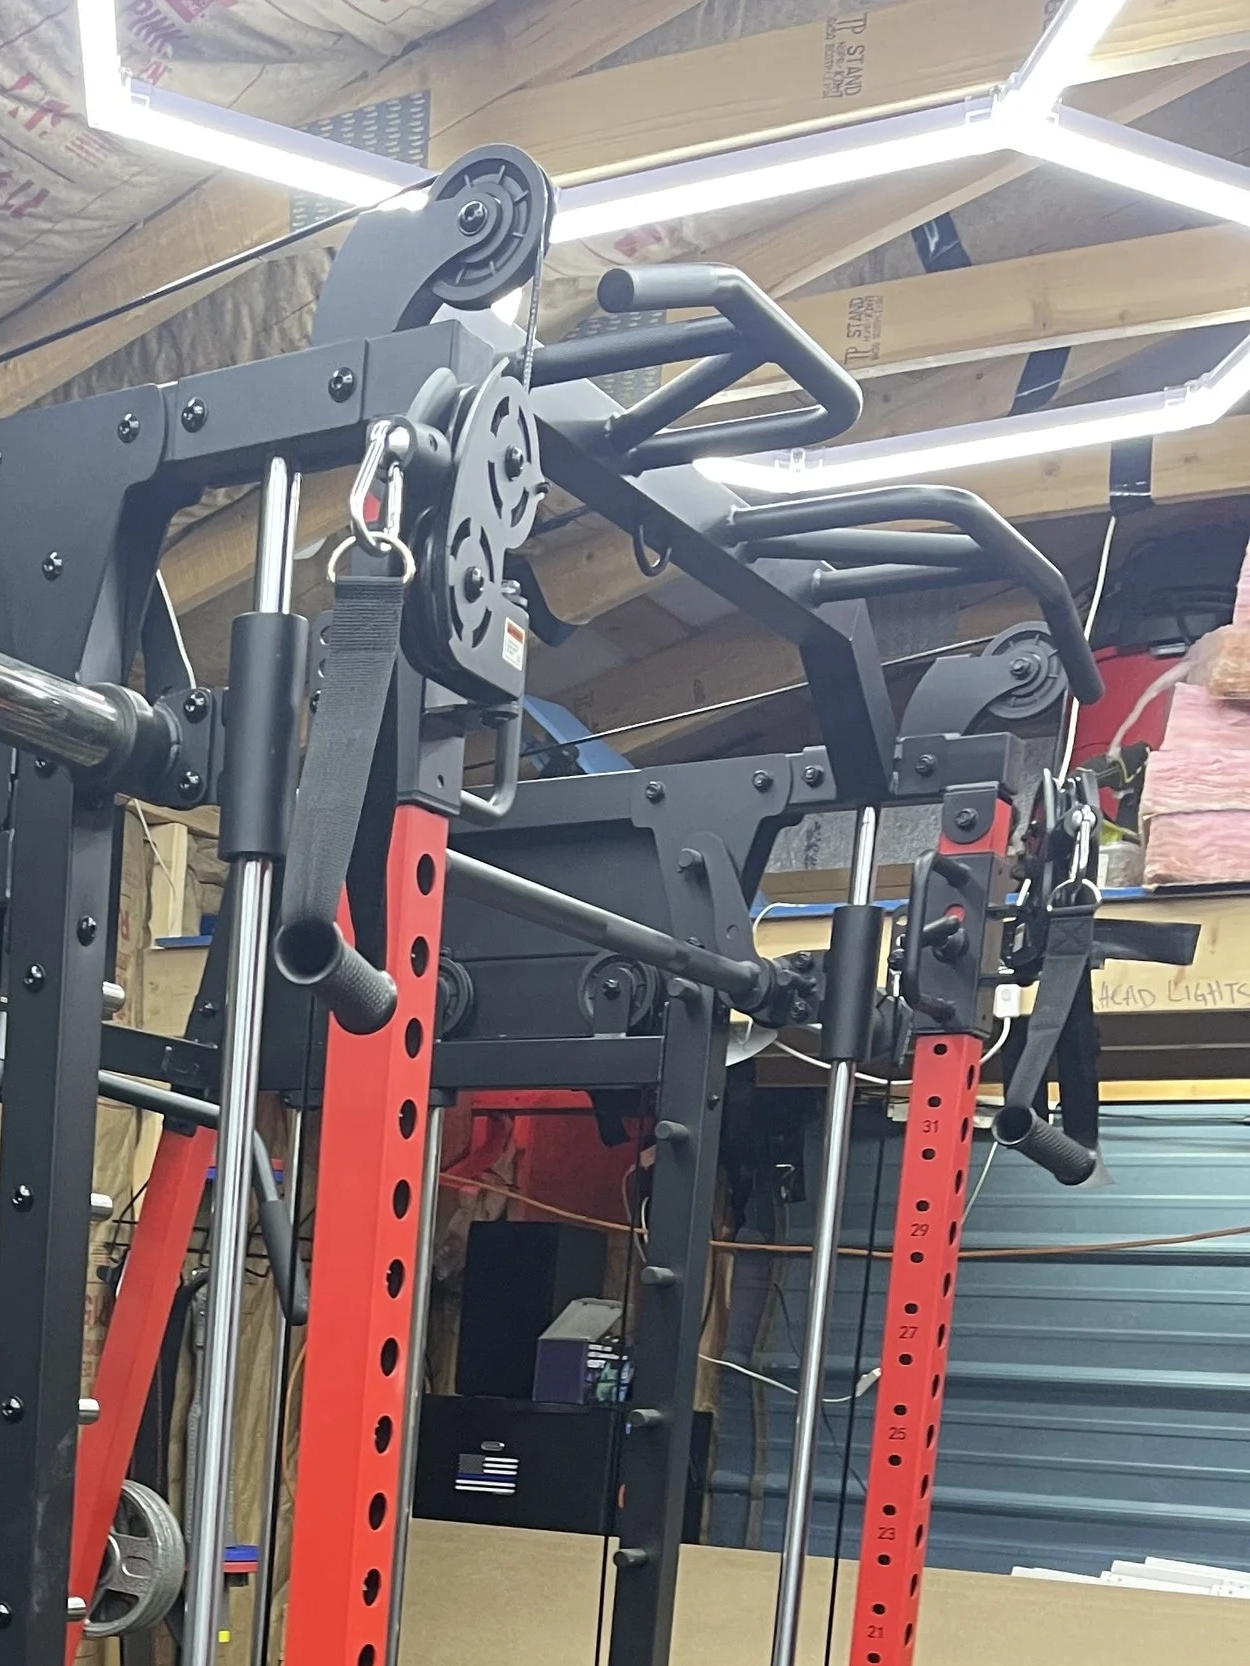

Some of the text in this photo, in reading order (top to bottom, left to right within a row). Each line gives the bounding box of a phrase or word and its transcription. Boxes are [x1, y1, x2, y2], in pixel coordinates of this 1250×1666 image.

[844, 44, 865, 96] STAND
[846, 296, 864, 339] STAND
[922, 1119, 939, 1134] 31
[910, 1223, 929, 1238] 29
[898, 1325, 918, 1340] 27
[888, 1427, 907, 1440] 25
[878, 1526, 896, 1541] 23
[866, 1625, 884, 1639] 21
